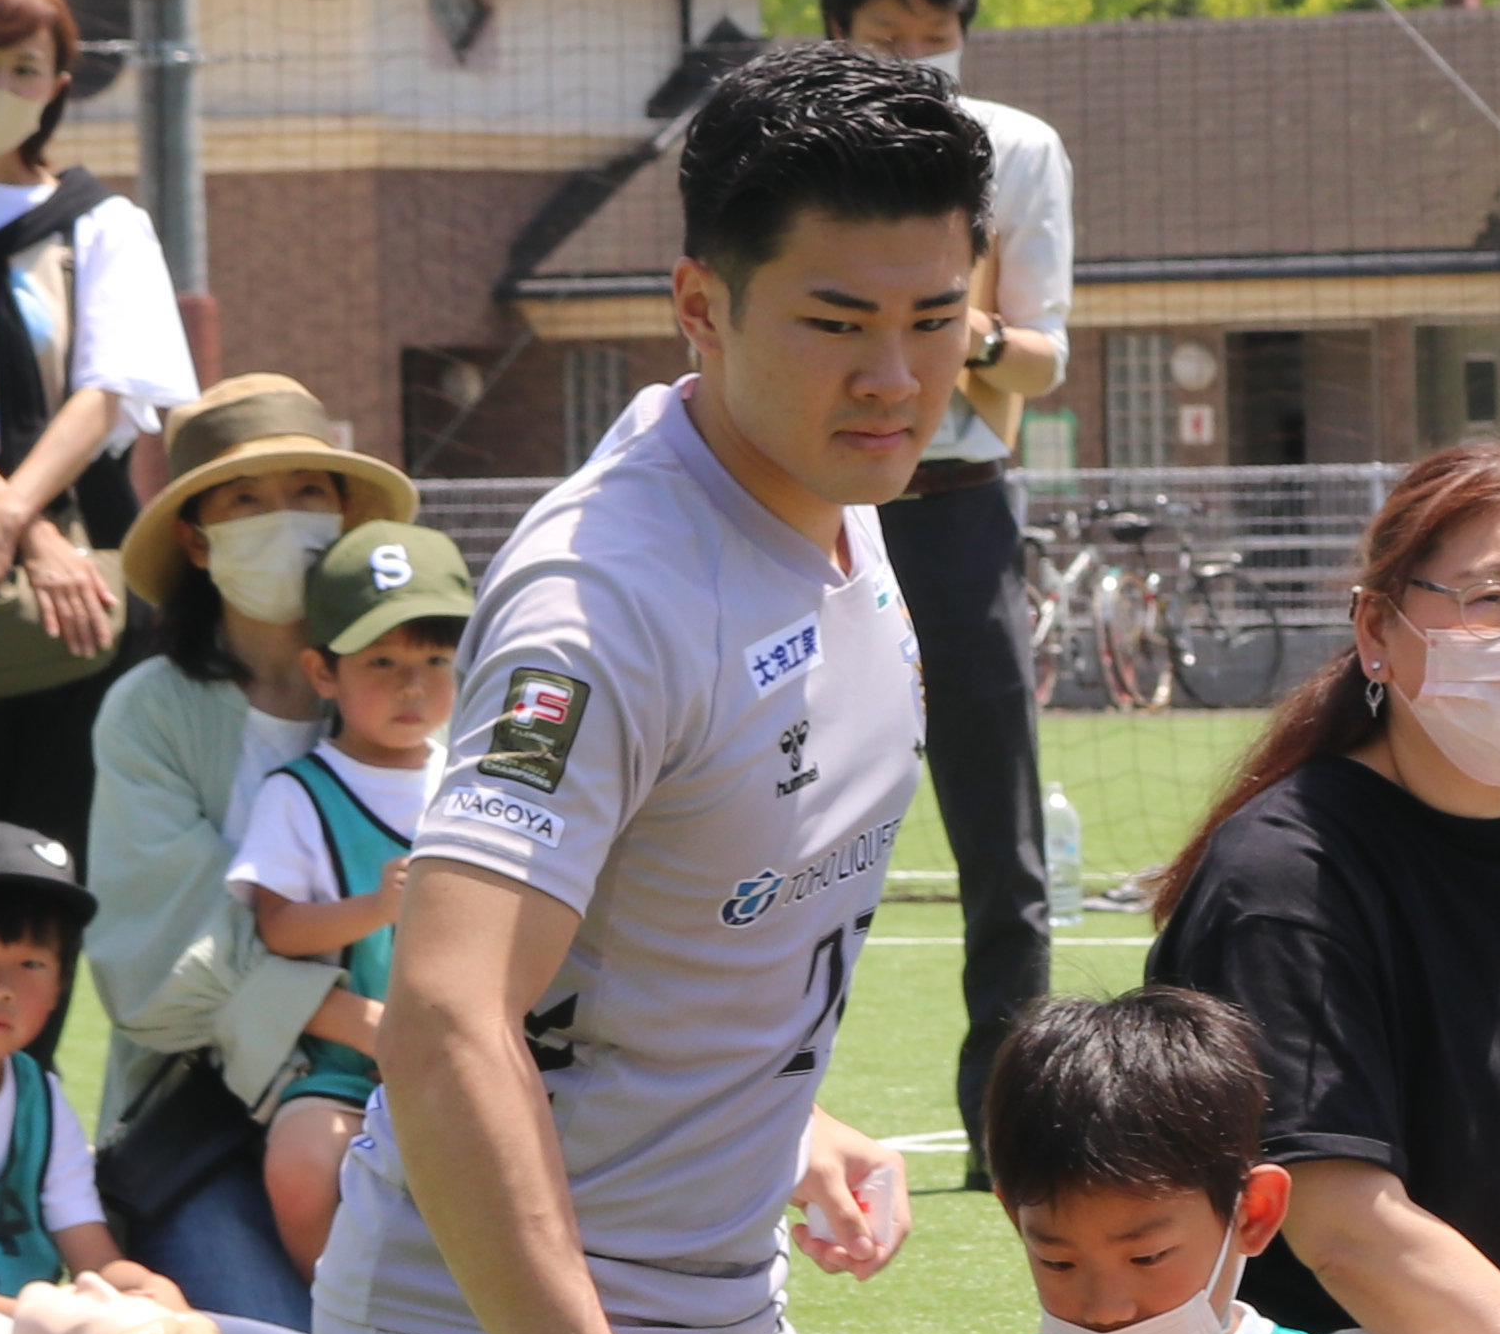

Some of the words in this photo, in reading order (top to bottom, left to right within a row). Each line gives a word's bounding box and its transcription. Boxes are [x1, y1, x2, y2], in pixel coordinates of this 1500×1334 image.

[370, 543, 413, 590] S
[776, 762, 820, 798] hummel
[453, 789, 554, 839] NAGOYA
